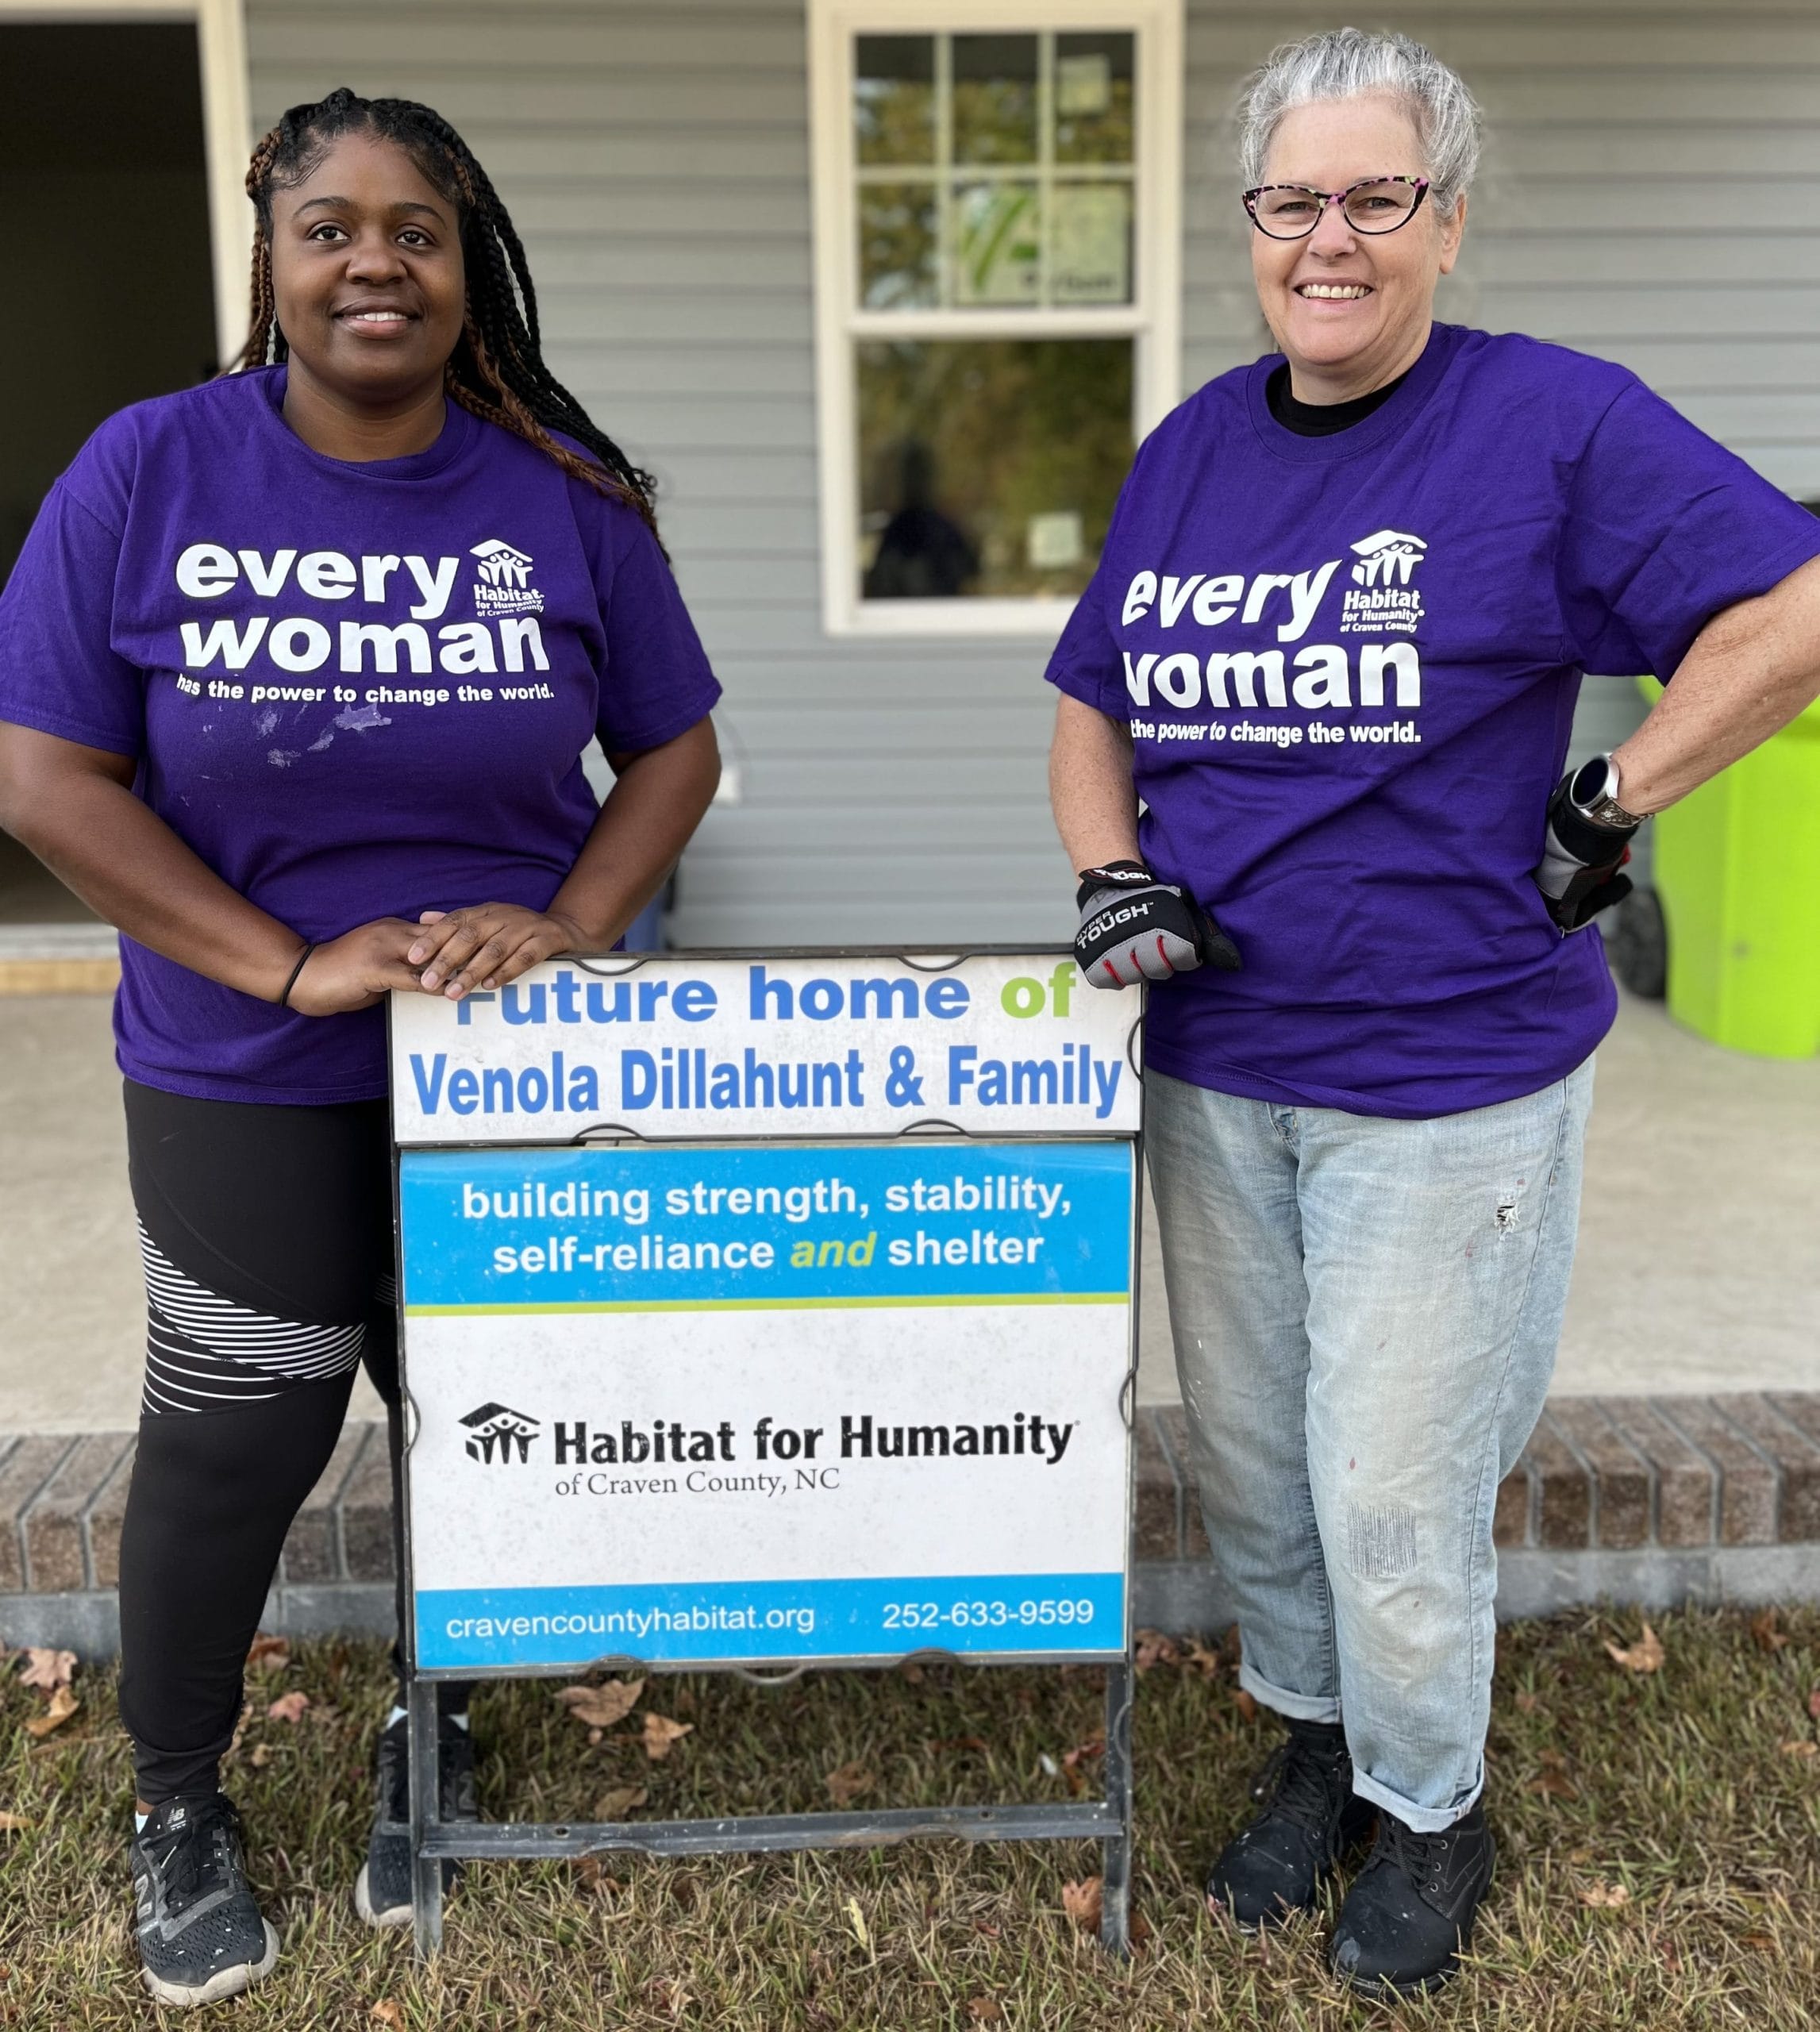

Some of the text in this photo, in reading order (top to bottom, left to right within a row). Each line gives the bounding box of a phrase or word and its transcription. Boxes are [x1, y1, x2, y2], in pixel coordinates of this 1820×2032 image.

[176, 543, 460, 620] every
[473, 583, 541, 601] Habitat
[1122, 559, 1343, 642] every
[1344, 588, 1421, 610] Habitat
[475, 599, 542, 610] for Humanity
[516, 604, 544, 613] County
[1341, 608, 1418, 623] for Humanity
[179, 616, 550, 674] woman
[1340, 621, 1418, 633] of Craven County
[176, 673, 555, 706] has the power to change the world.
[1130, 718, 1422, 748] the power to change the world.
[1077, 903, 1149, 949] TOUGH
[749, 966, 970, 1021] home
[1000, 962, 1077, 1019] of
[410, 1043, 1122, 1119] Venola Dillahunt & Family
[464, 1175, 1071, 1225] building strength, stability,
[493, 1229, 1044, 1274] self-reliance and shelter
[554, 1411, 1074, 1465] Habitat for Humanity
[556, 1468, 840, 1499] of Craven County, NC
[446, 1599, 1095, 1640] cravencountyhabitat.org 252-633-9599
